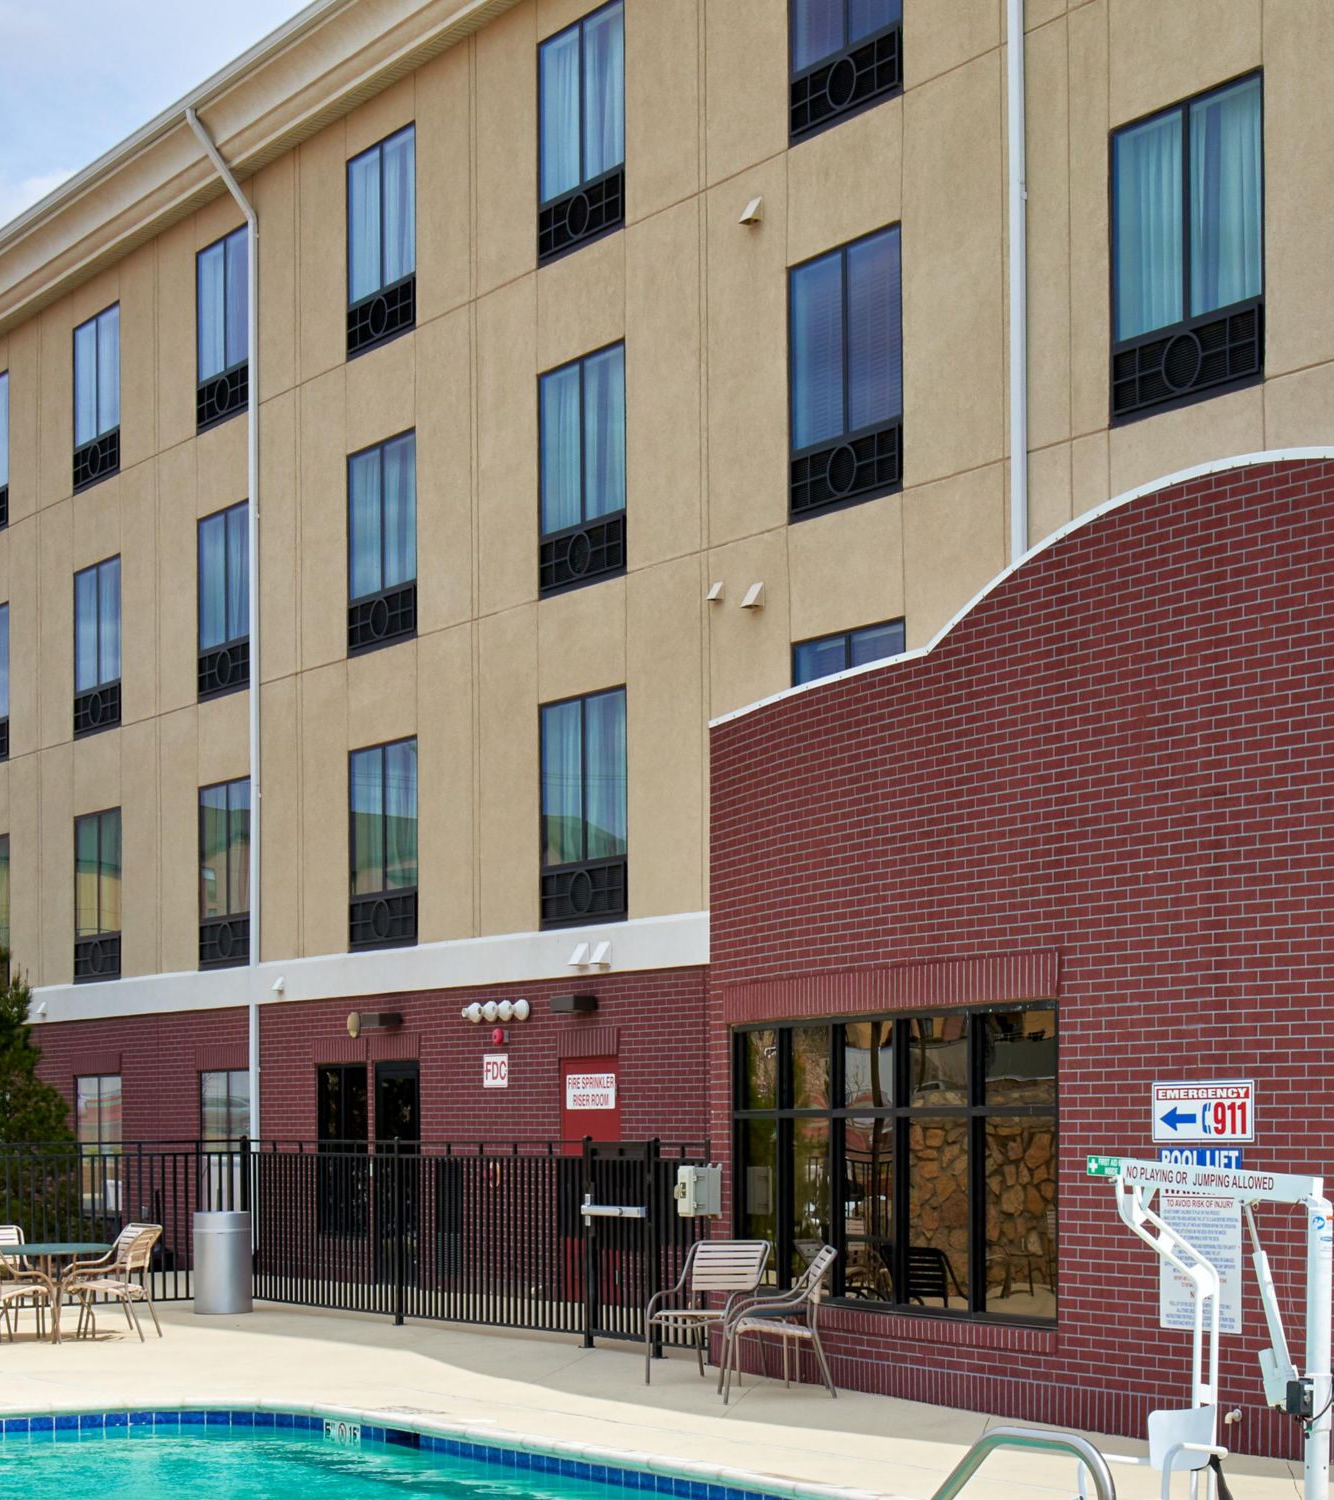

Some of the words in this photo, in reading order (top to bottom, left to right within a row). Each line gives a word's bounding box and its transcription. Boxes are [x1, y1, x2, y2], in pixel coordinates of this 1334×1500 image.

[485, 1061, 507, 1080] FDC
[568, 1077, 581, 1089] FIRE
[582, 1076, 614, 1089] SPRINKLER
[573, 1094, 590, 1107] RISER
[591, 1094, 609, 1107] ROOM
[1158, 1087, 1247, 1099] EMERGENCY
[1213, 1101, 1246, 1135] 911
[1206, 1150, 1239, 1169] LIFT
[1127, 1166, 1138, 1180] NO
[1140, 1167, 1174, 1184] PLAYING
[1175, 1171, 1188, 1185] OR
[1192, 1173, 1230, 1188] JUMPING
[1231, 1175, 1274, 1191] ALLOWED
[1167, 1199, 1174, 1207] TO
[1175, 1200, 1191, 1208] AVOID
[1192, 1200, 1204, 1208] RISK
[1205, 1200, 1213, 1208] OF
[1214, 1201, 1234, 1209] INJURY
